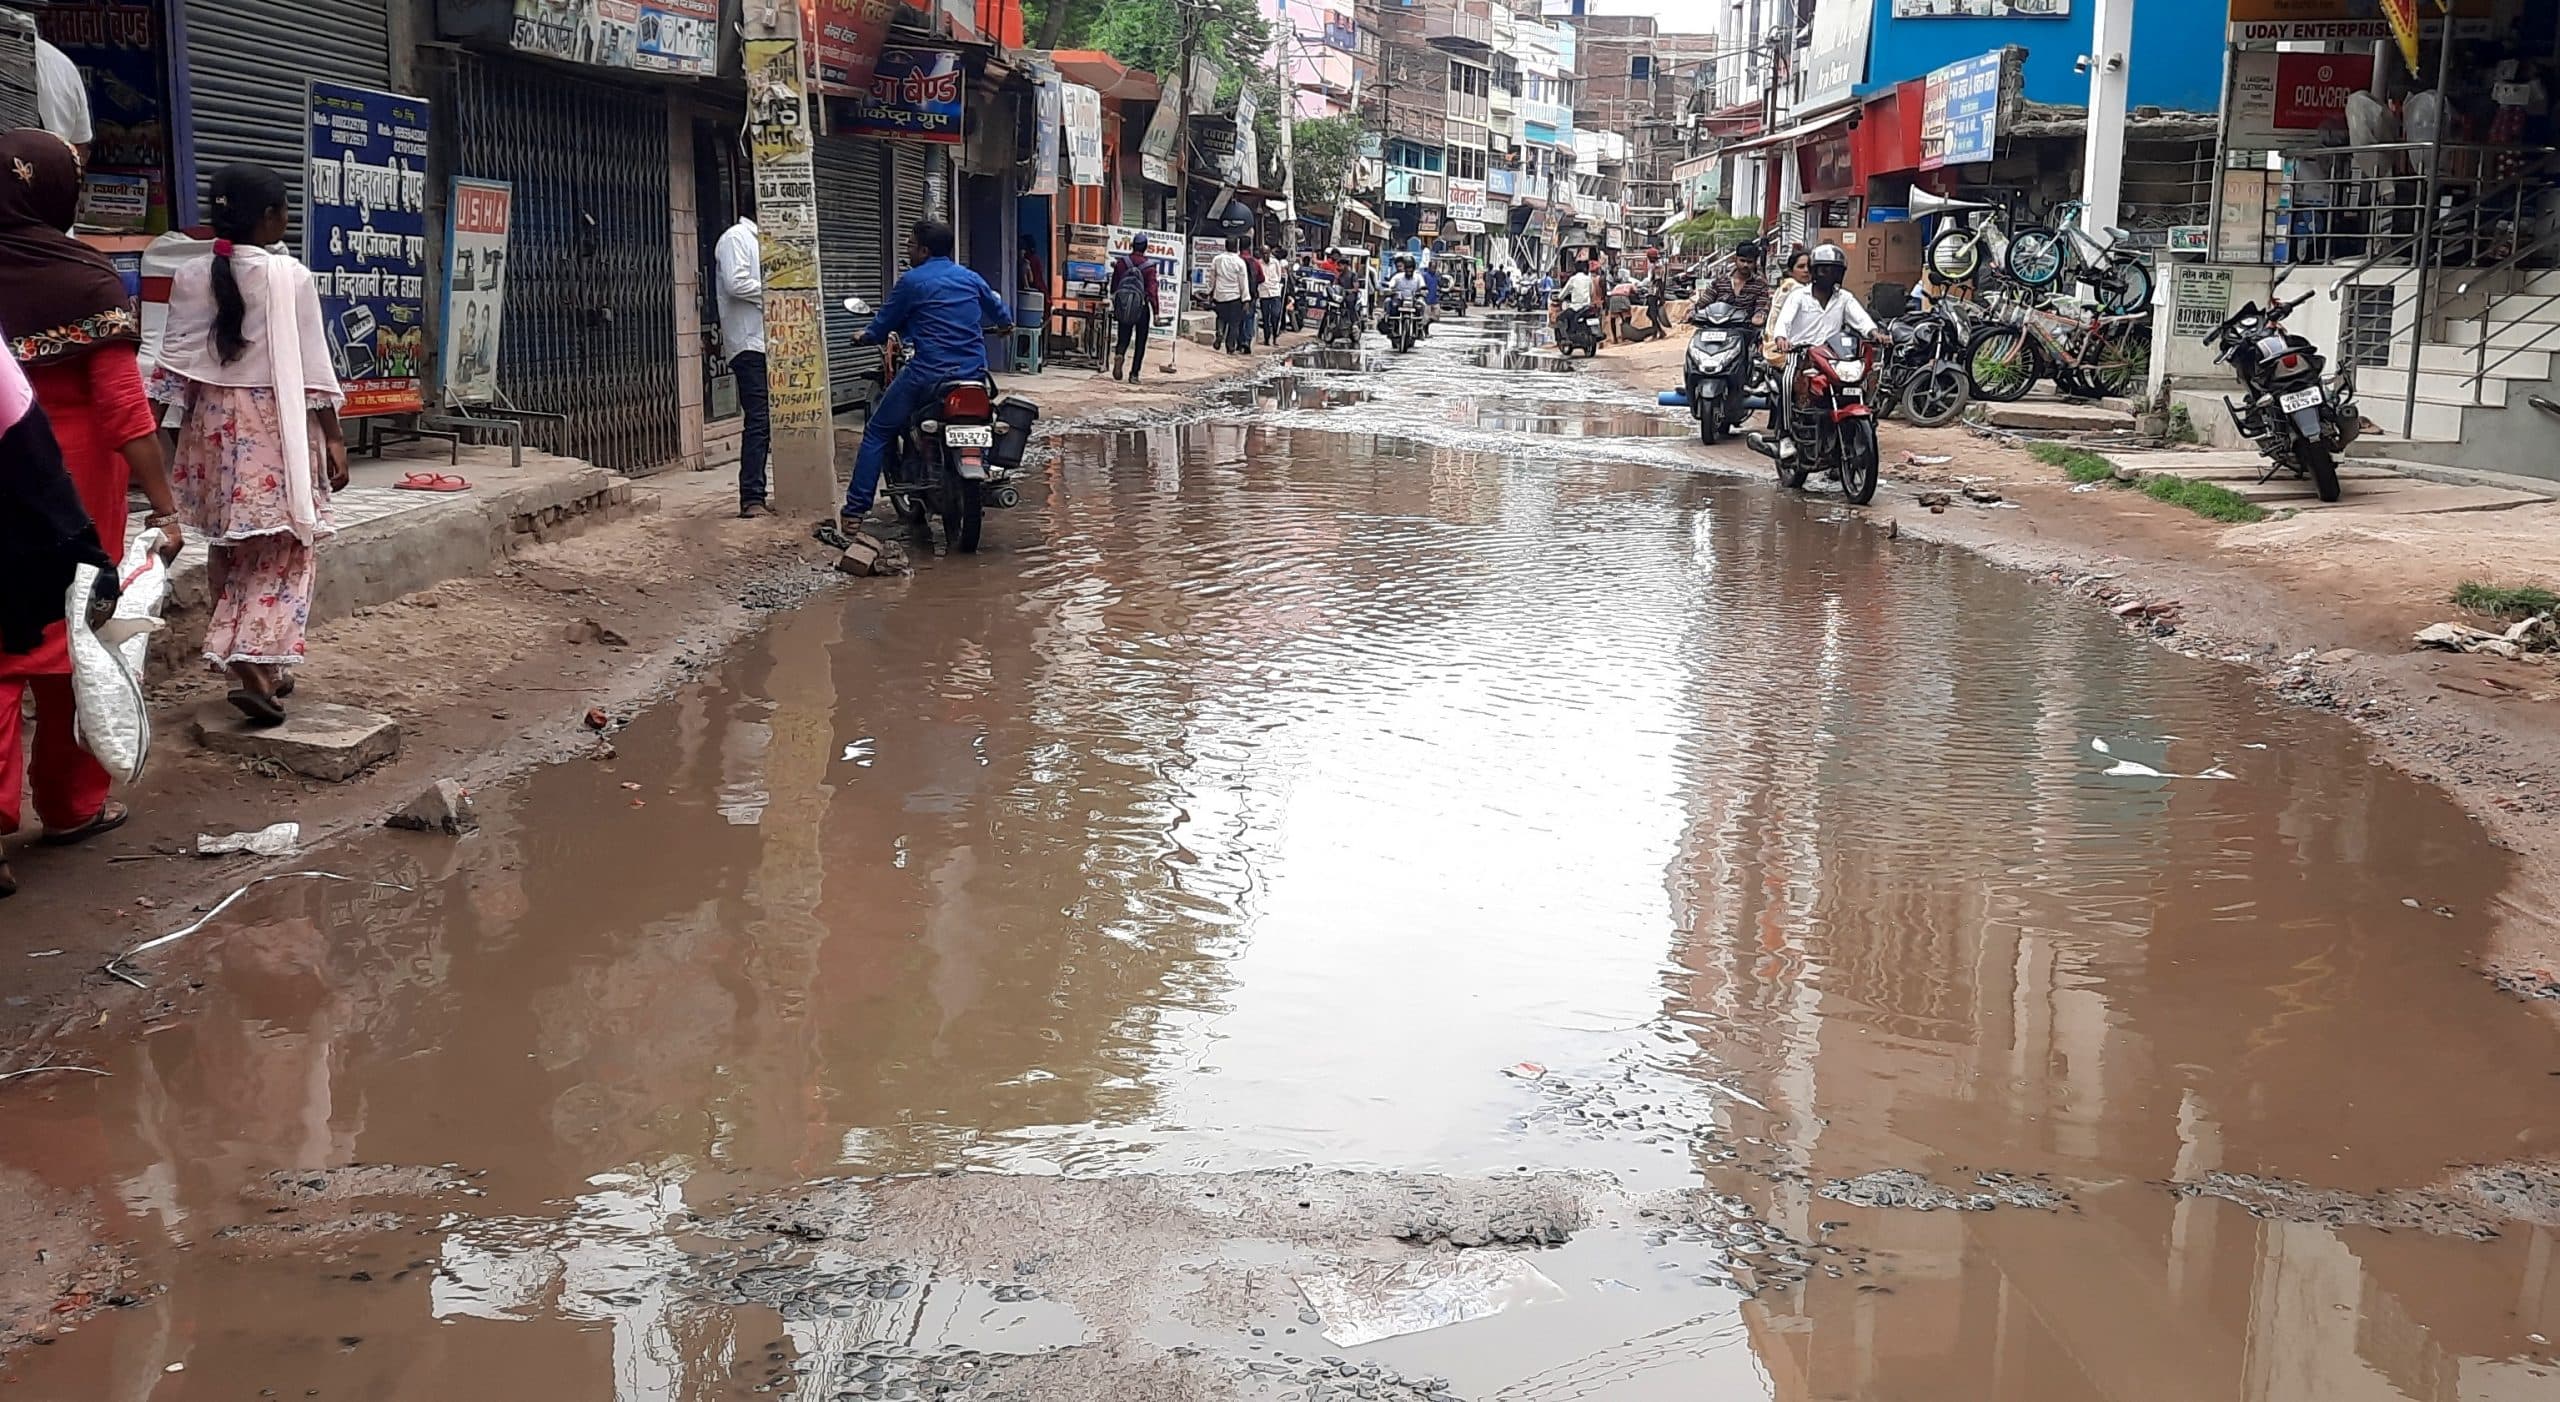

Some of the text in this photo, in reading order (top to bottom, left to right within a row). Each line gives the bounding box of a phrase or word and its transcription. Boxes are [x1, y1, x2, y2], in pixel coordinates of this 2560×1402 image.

[2245, 24, 2288, 39] UDAY
[903, 65, 960, 105] बैण्ड
[311, 157, 341, 206] राजा
[457, 195, 504, 228] USHA
[329, 226, 343, 255] &
[346, 225, 402, 265] म्यूजिकल
[1114, 239, 1175, 257] VISHA
